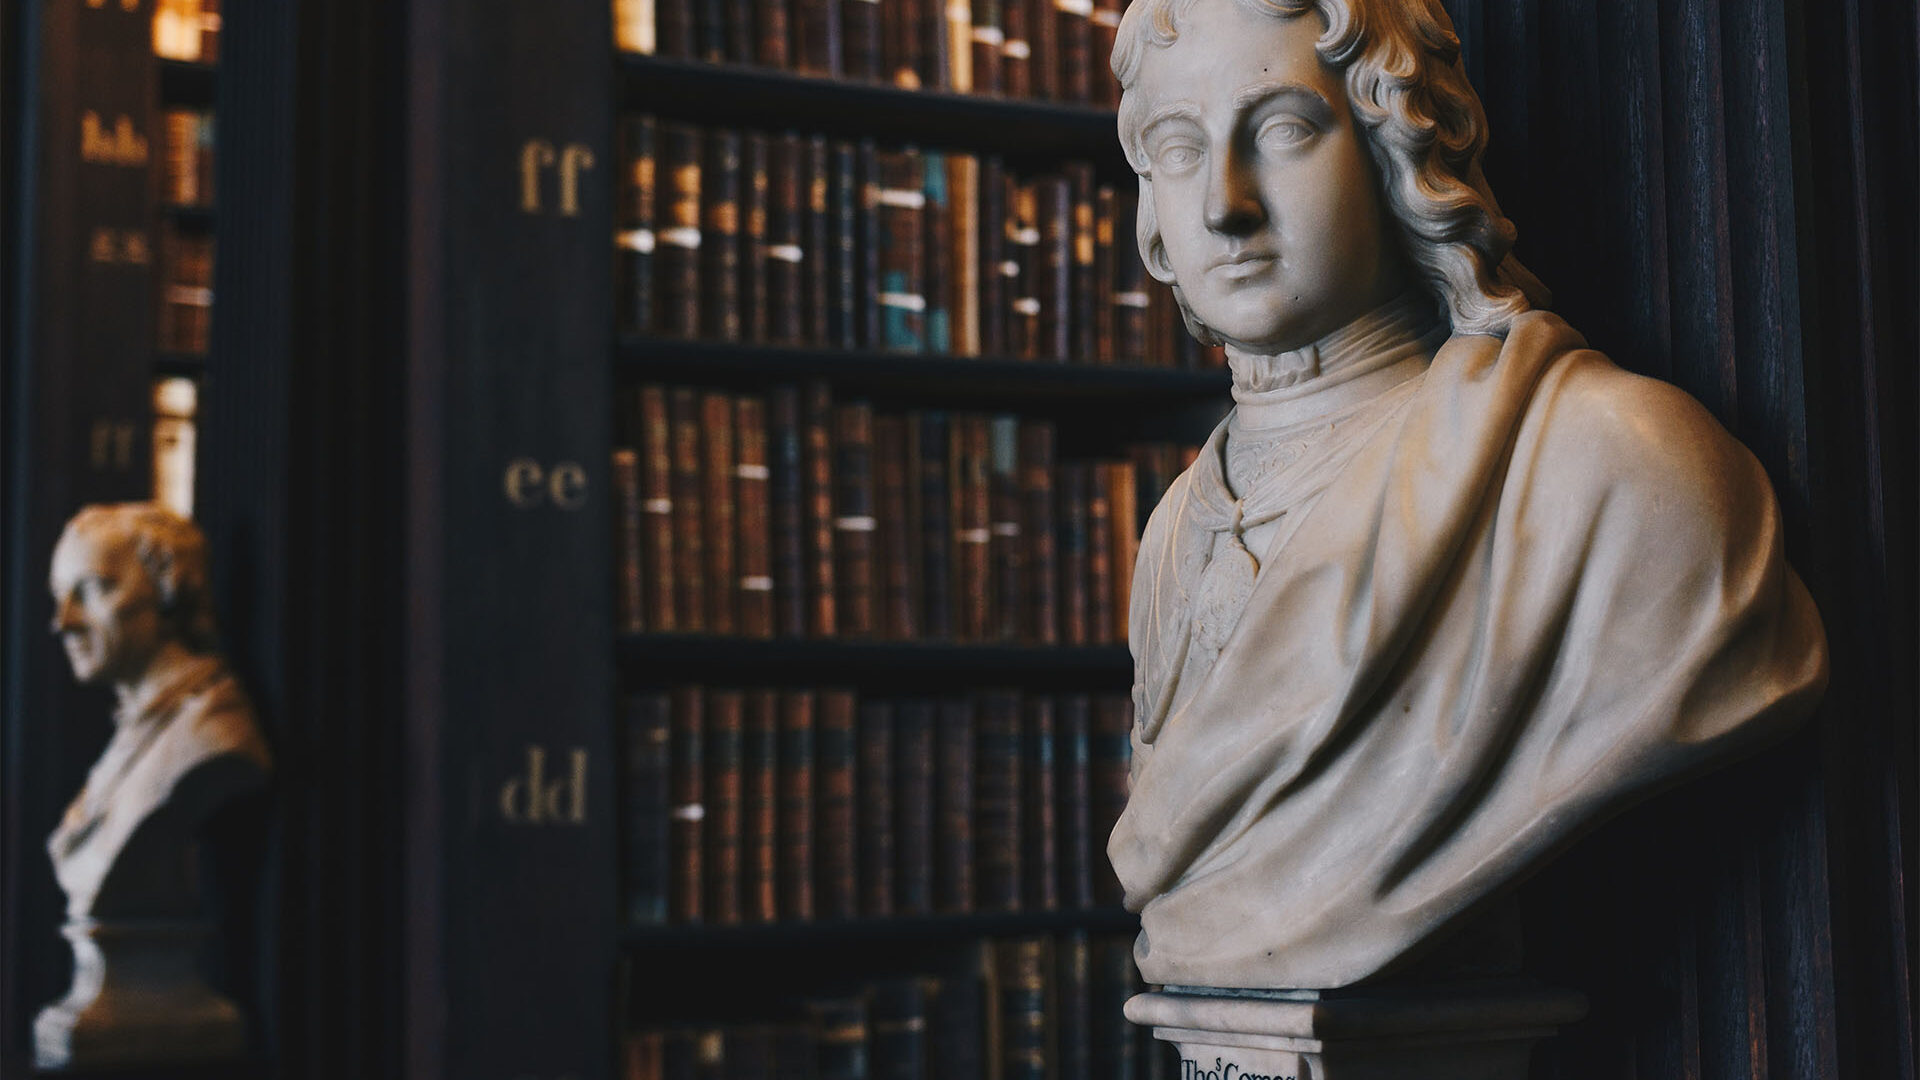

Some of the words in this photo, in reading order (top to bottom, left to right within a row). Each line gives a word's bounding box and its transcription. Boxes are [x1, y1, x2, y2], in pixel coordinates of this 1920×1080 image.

[520, 140, 595, 217] ff
[504, 457, 588, 511] ee
[501, 747, 588, 825] dd
